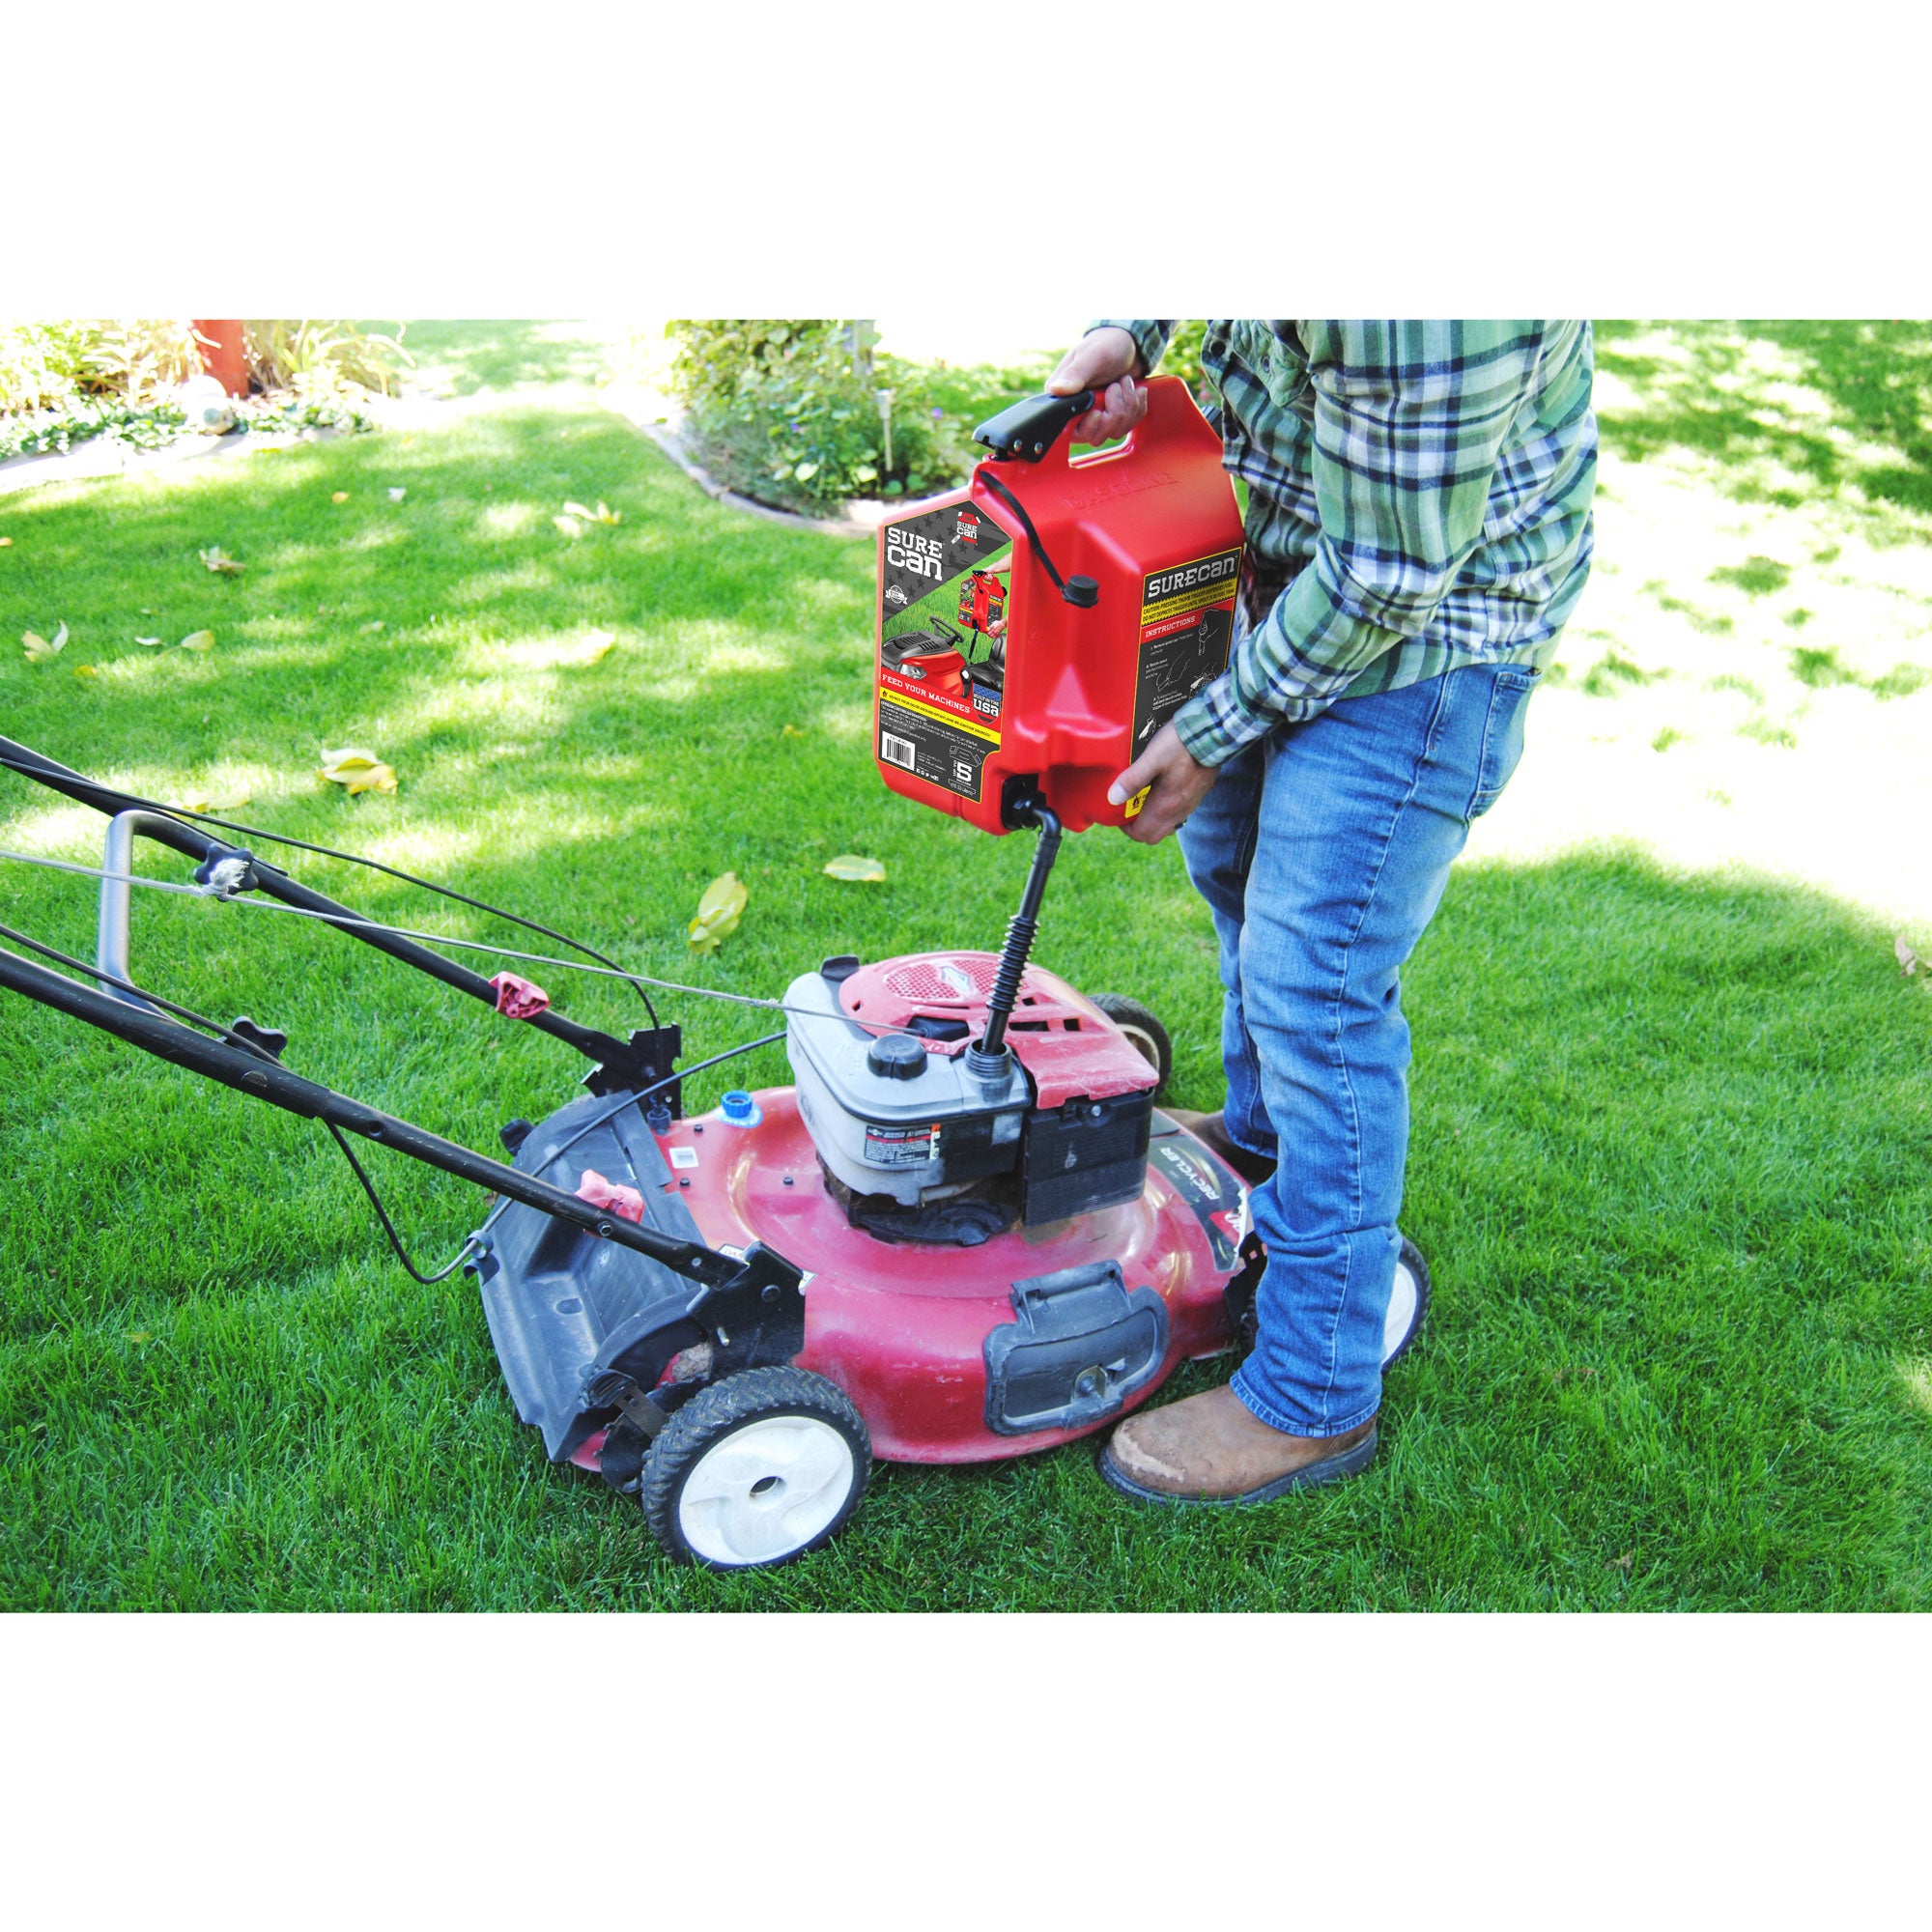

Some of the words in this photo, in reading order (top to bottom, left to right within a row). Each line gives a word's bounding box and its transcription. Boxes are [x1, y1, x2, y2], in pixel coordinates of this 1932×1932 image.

[957, 521, 978, 532] SURE
[888, 526, 943, 559] SURE
[1145, 615, 1196, 639] INSTRUCTIONS
[882, 673, 903, 687] FEED
[904, 682, 927, 697] YOUR
[928, 691, 971, 714] MACHINES
[956, 761, 972, 782] 5
[1160, 1147, 1220, 1201] RECYCLER
